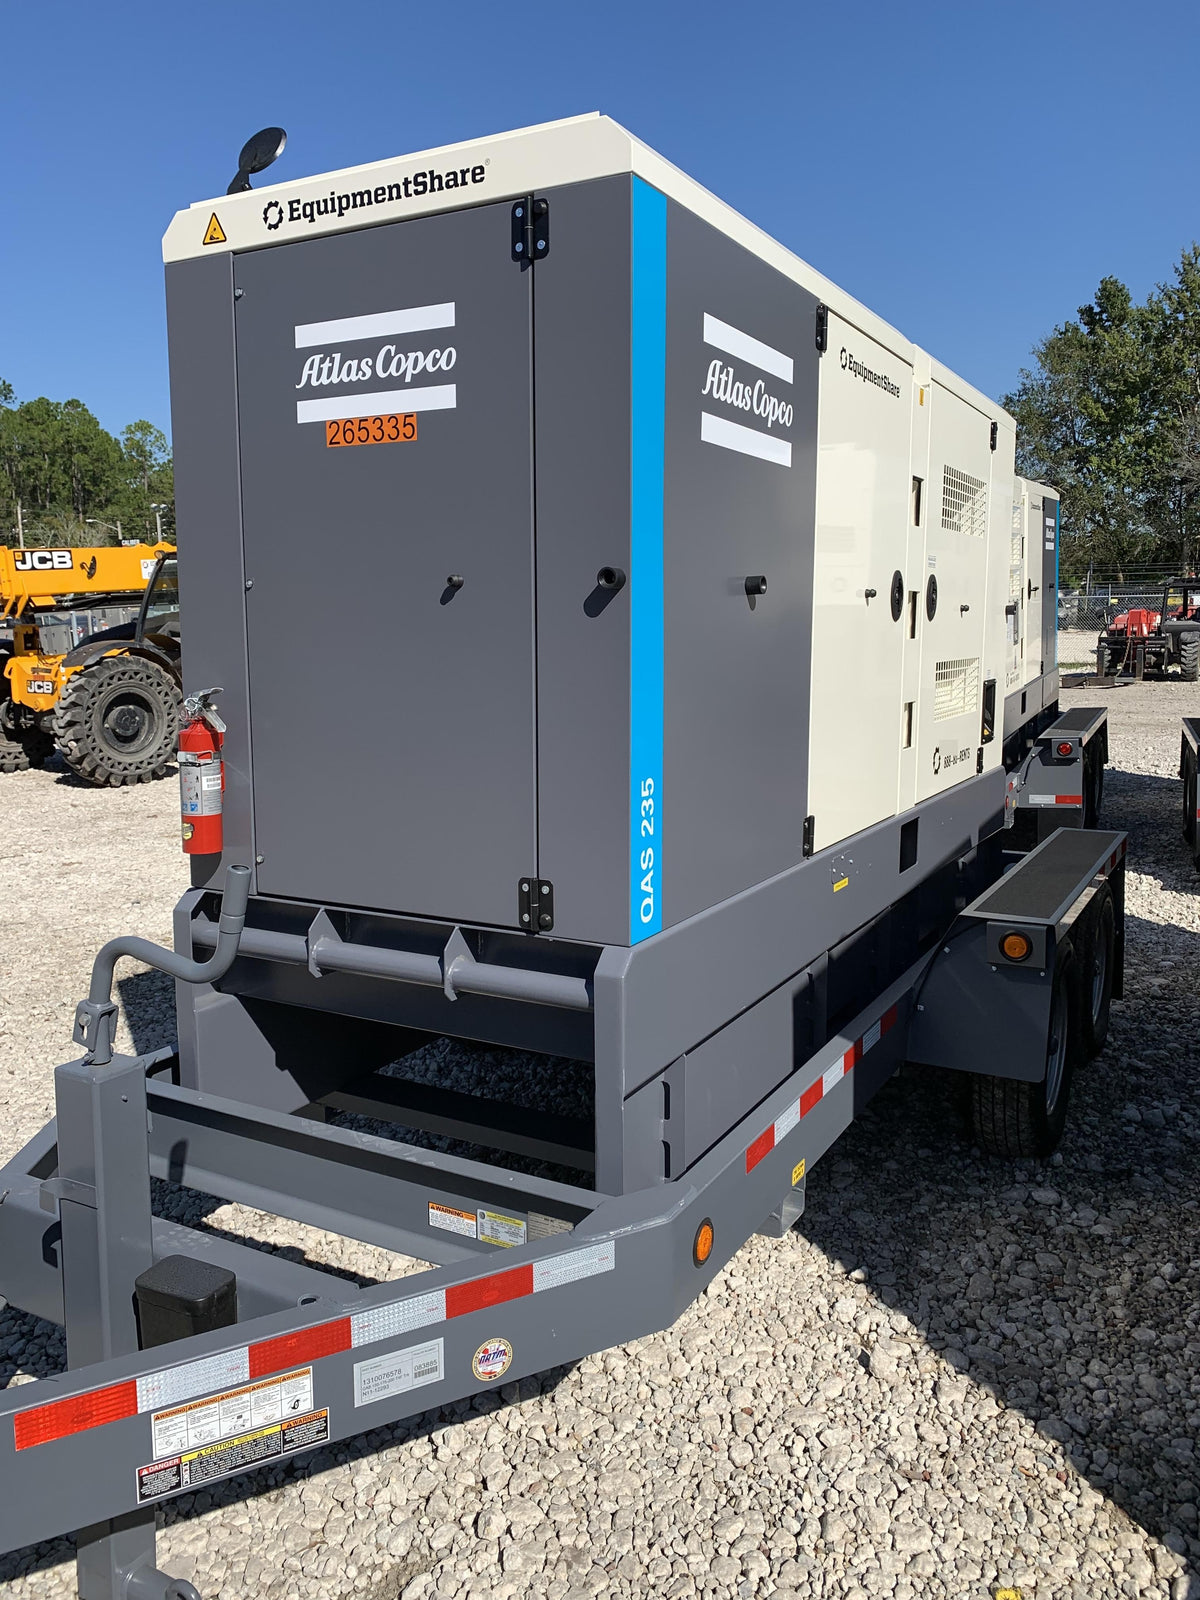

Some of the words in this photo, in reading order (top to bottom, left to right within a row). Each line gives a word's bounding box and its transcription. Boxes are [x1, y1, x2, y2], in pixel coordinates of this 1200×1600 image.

[296, 352, 373, 389] Atlas
[376, 344, 457, 383] Copco
[701, 359, 752, 412] Atlas
[753, 379, 793, 428] Copco
[328, 414, 416, 446] 265335
[15, 551, 73, 570] JCB
[27, 680, 53, 694] JCB
[640, 777, 655, 838] 235
[640, 847, 655, 924] QAS
[435, 1205, 464, 1218] WARNING
[285, 1369, 311, 1381] WARNING
[255, 1378, 280, 1390] WARNING
[224, 1387, 249, 1399] WARNING
[192, 1397, 218, 1409] WARNING
[159, 1407, 186, 1419] WARNING
[292, 1413, 323, 1426] WARNING
[204, 1440, 235, 1454] CAUTION
[148, 1458, 180, 1473] DANGER
